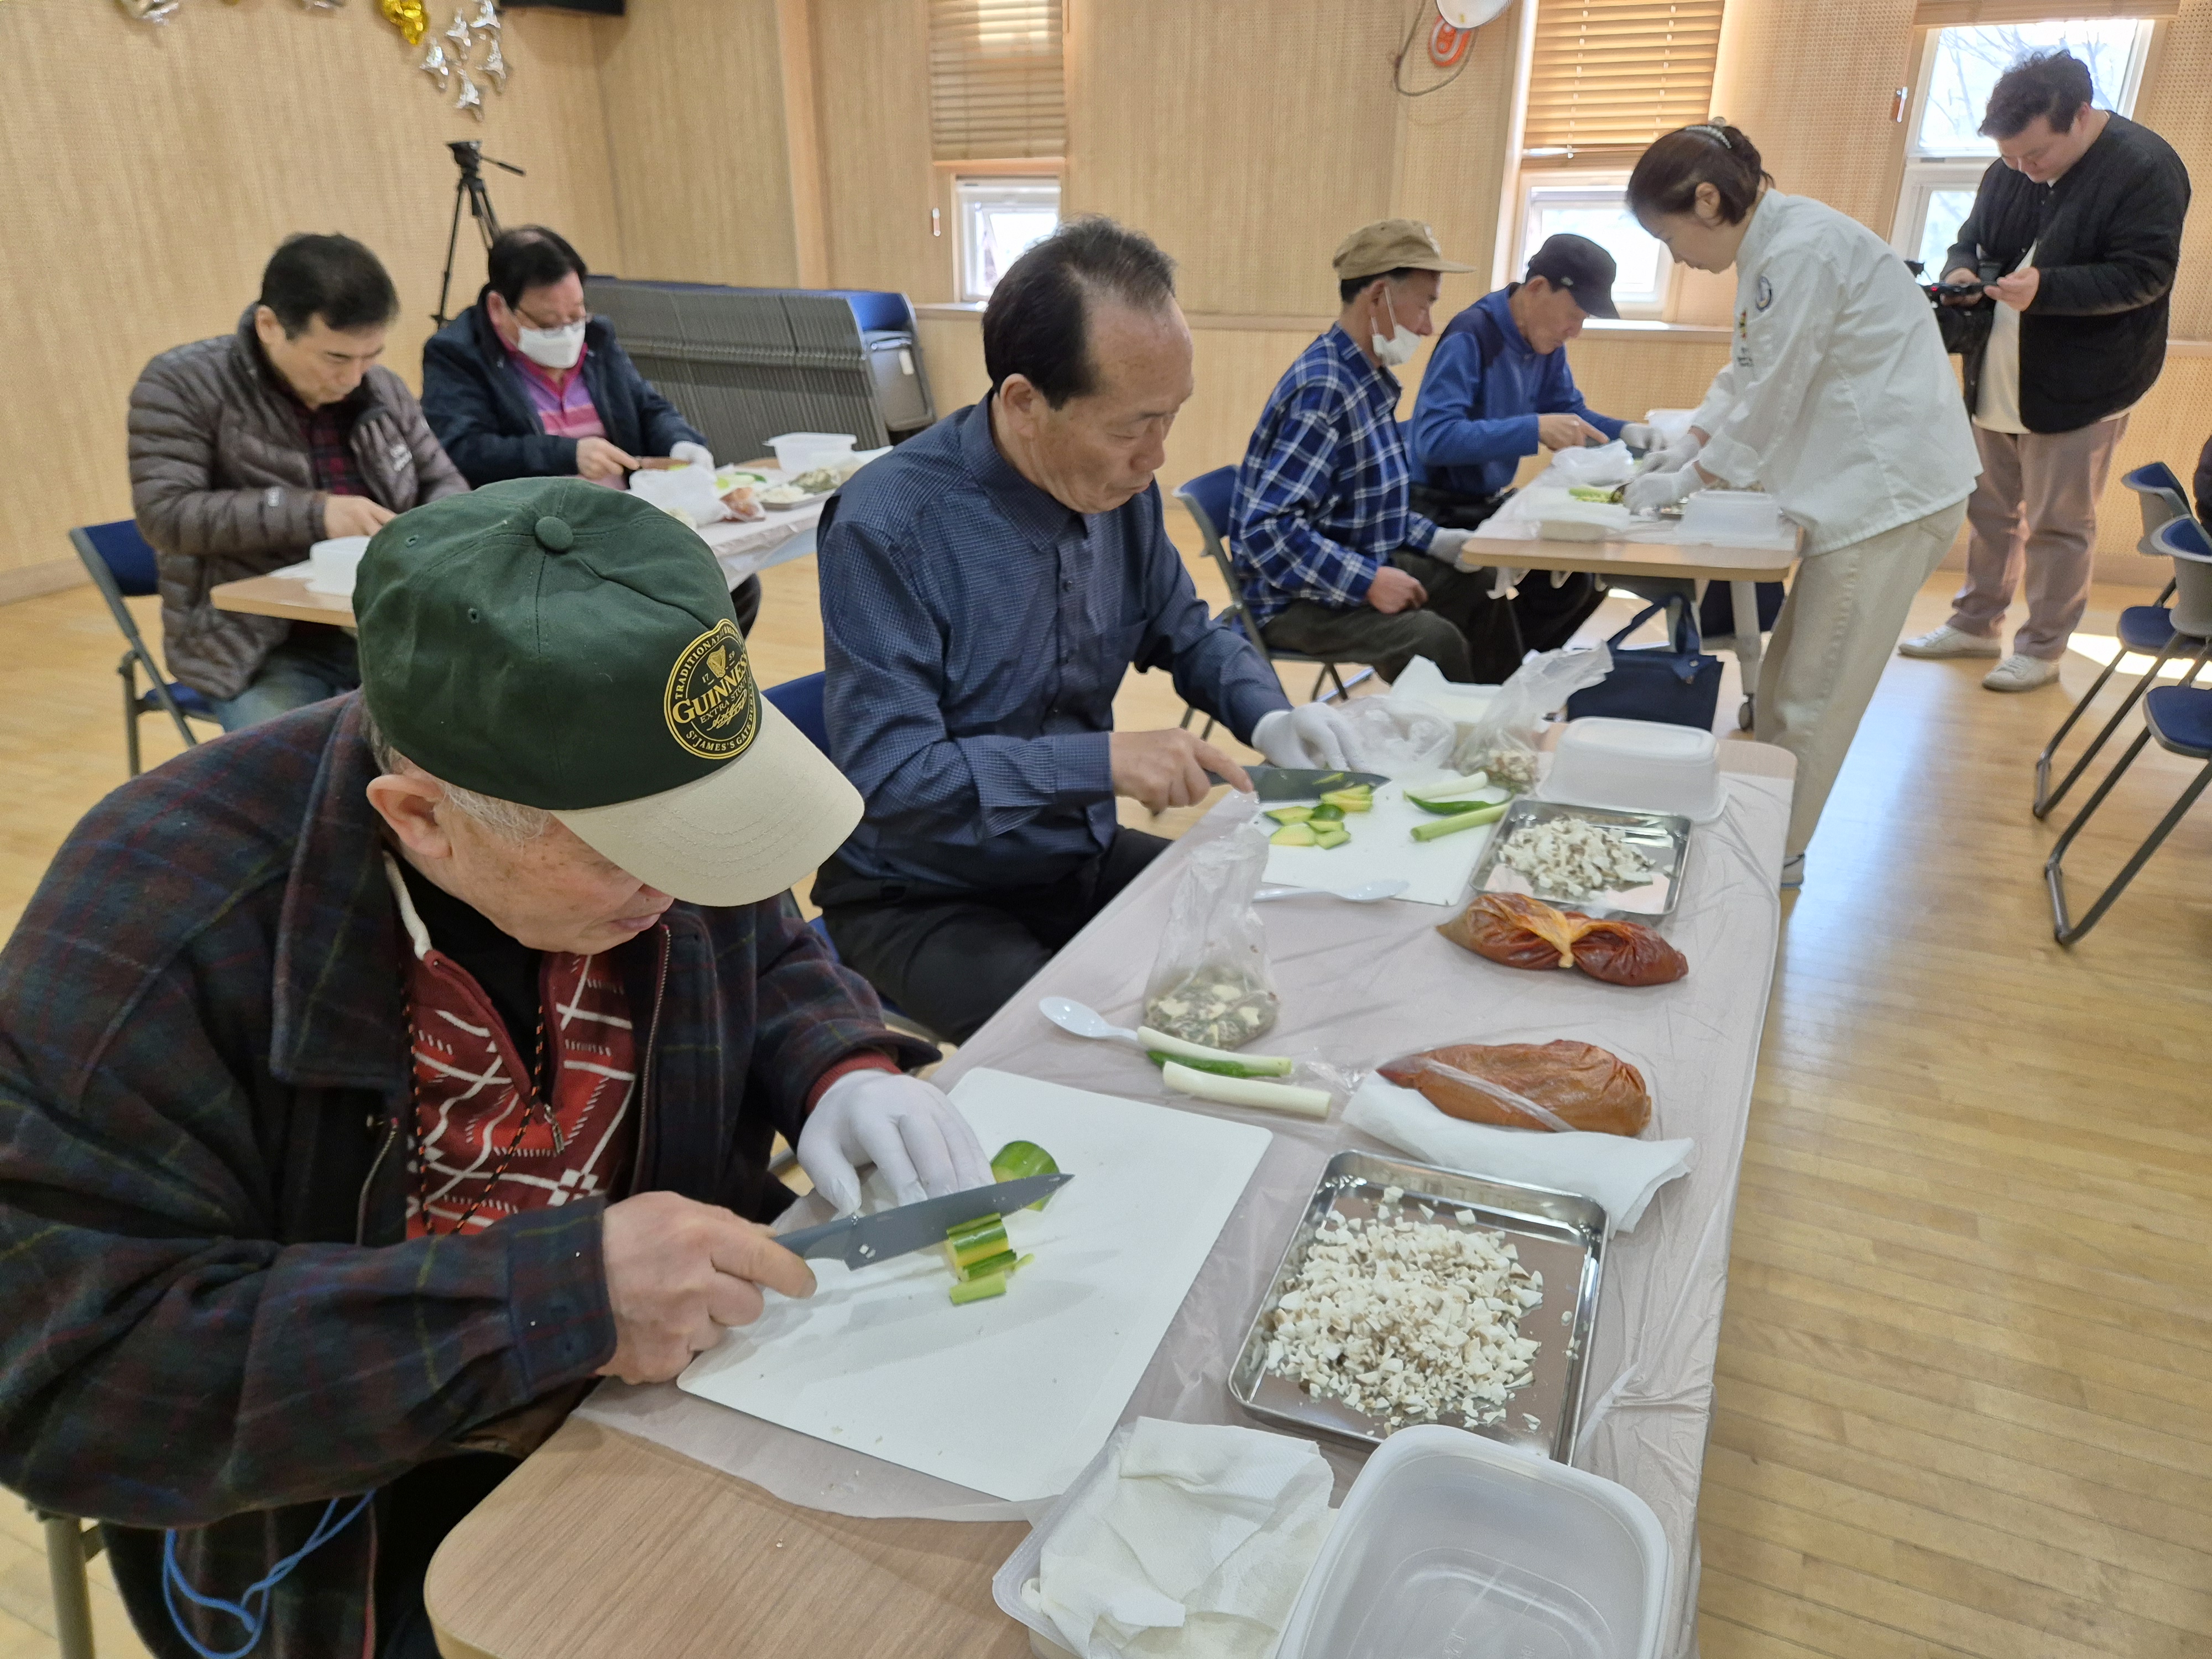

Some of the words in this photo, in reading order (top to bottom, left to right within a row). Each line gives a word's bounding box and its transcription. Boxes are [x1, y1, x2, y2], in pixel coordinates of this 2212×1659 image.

[672, 653, 747, 723] GUINNES
[700, 700, 730, 724] EXTRA
[731, 676, 747, 702] STOUT
[692, 738, 735, 751] JAMES'S
[736, 722, 752, 744] GATE
